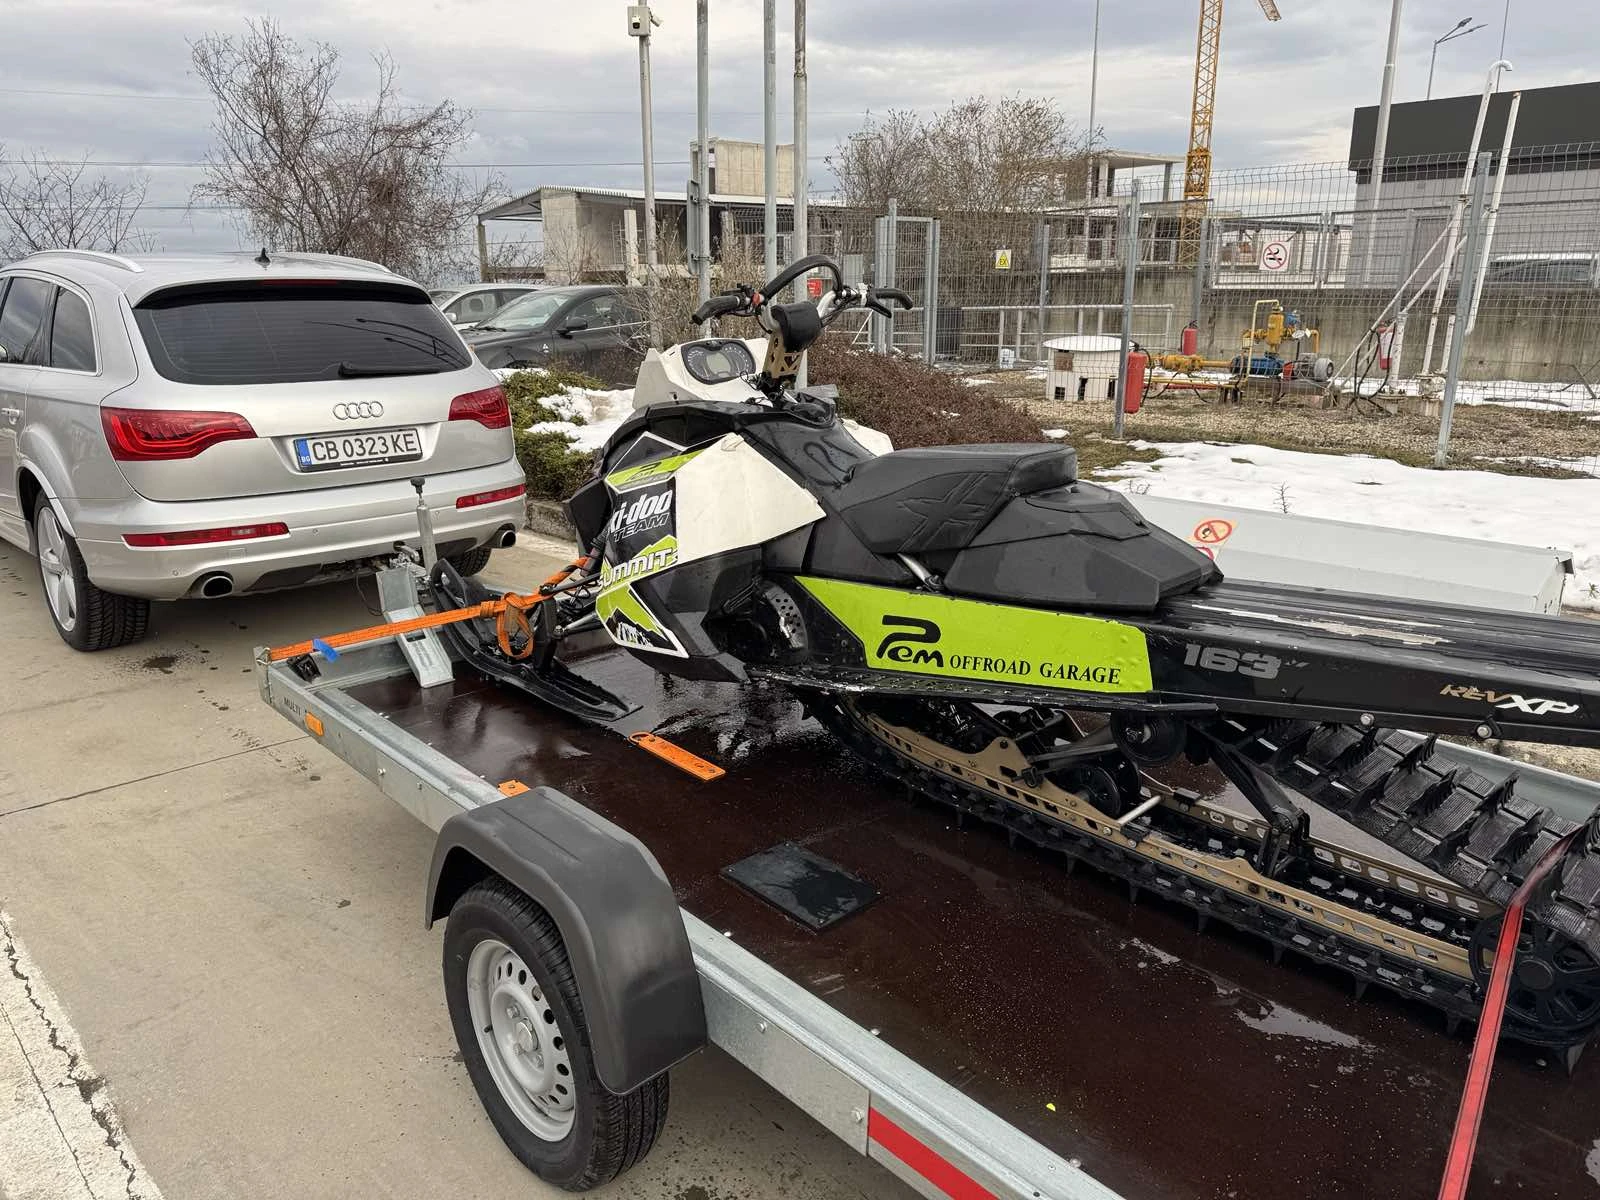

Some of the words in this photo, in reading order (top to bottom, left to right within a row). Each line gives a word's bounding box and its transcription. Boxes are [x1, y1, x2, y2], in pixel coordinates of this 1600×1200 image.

[312, 441, 339, 461] CB
[343, 436, 389, 457] 0323
[391, 433, 417, 453] KE
[614, 512, 670, 543] TEAM
[949, 654, 1031, 676] OFFROAD
[1039, 662, 1121, 685] GARAGE
[1183, 643, 1282, 680] 163
